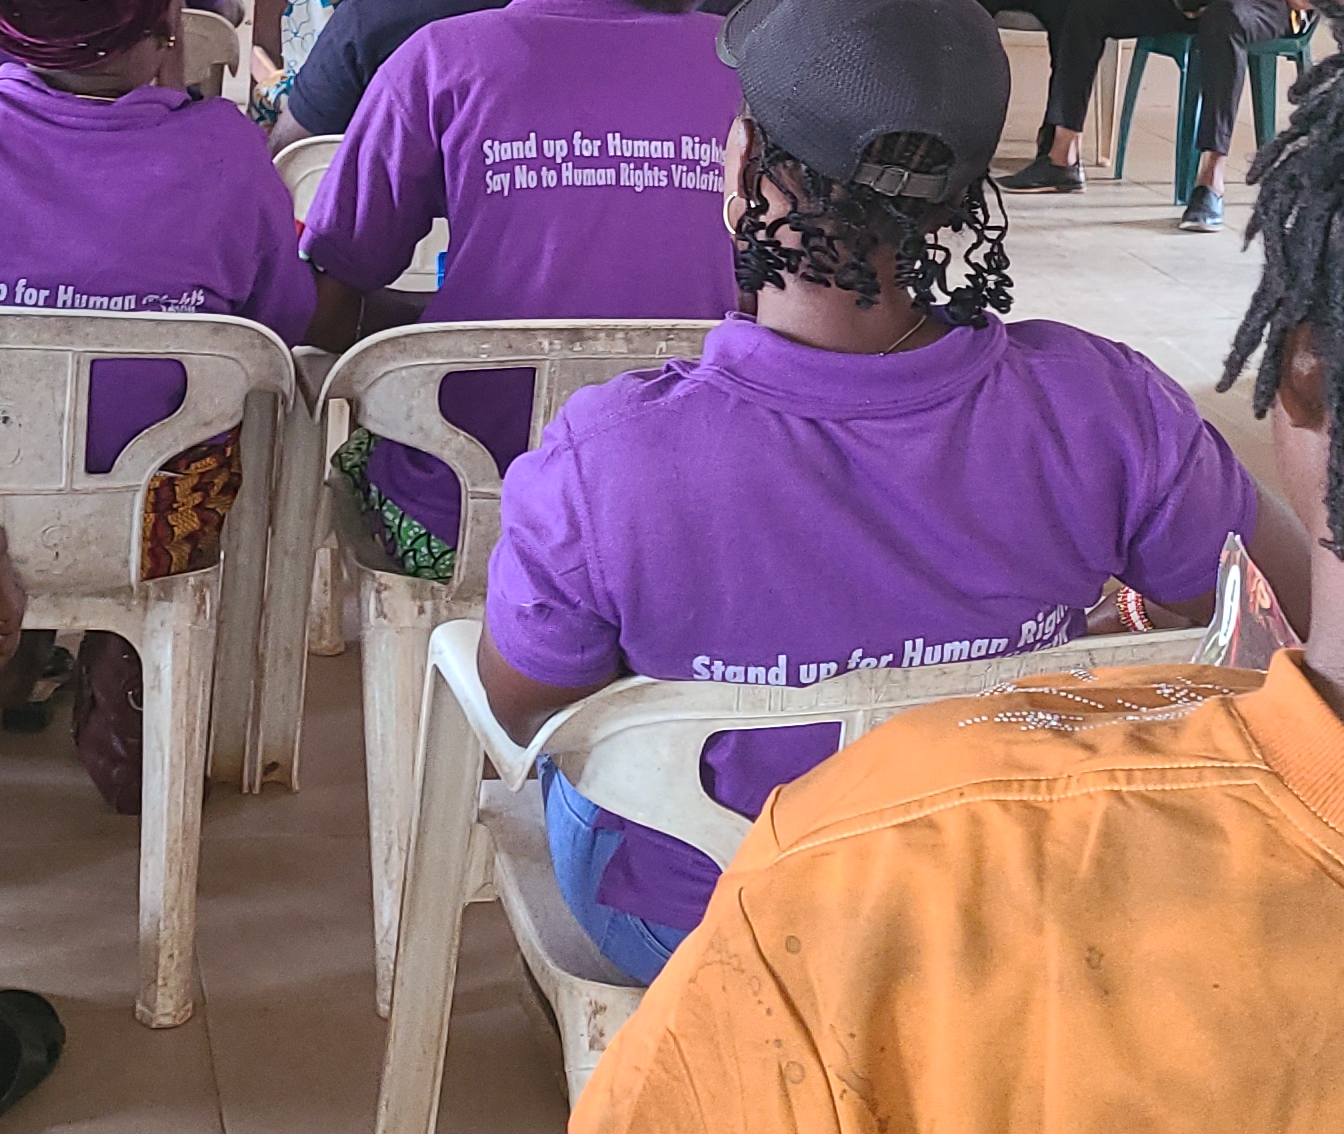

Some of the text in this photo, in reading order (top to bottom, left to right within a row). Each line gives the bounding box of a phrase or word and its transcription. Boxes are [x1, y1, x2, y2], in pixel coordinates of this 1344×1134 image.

[482, 132, 537, 166] Stand
[542, 138, 569, 164] up
[572, 131, 601, 159] for
[607, 132, 675, 160] Human
[486, 161, 724, 196] Say No to Human Rights Violatio
[15, 278, 50, 307] for
[57, 284, 136, 311] Human
[692, 655, 788, 686] Stand
[799, 658, 838, 683] up
[848, 647, 895, 670] for
[901, 637, 1009, 668] Human
